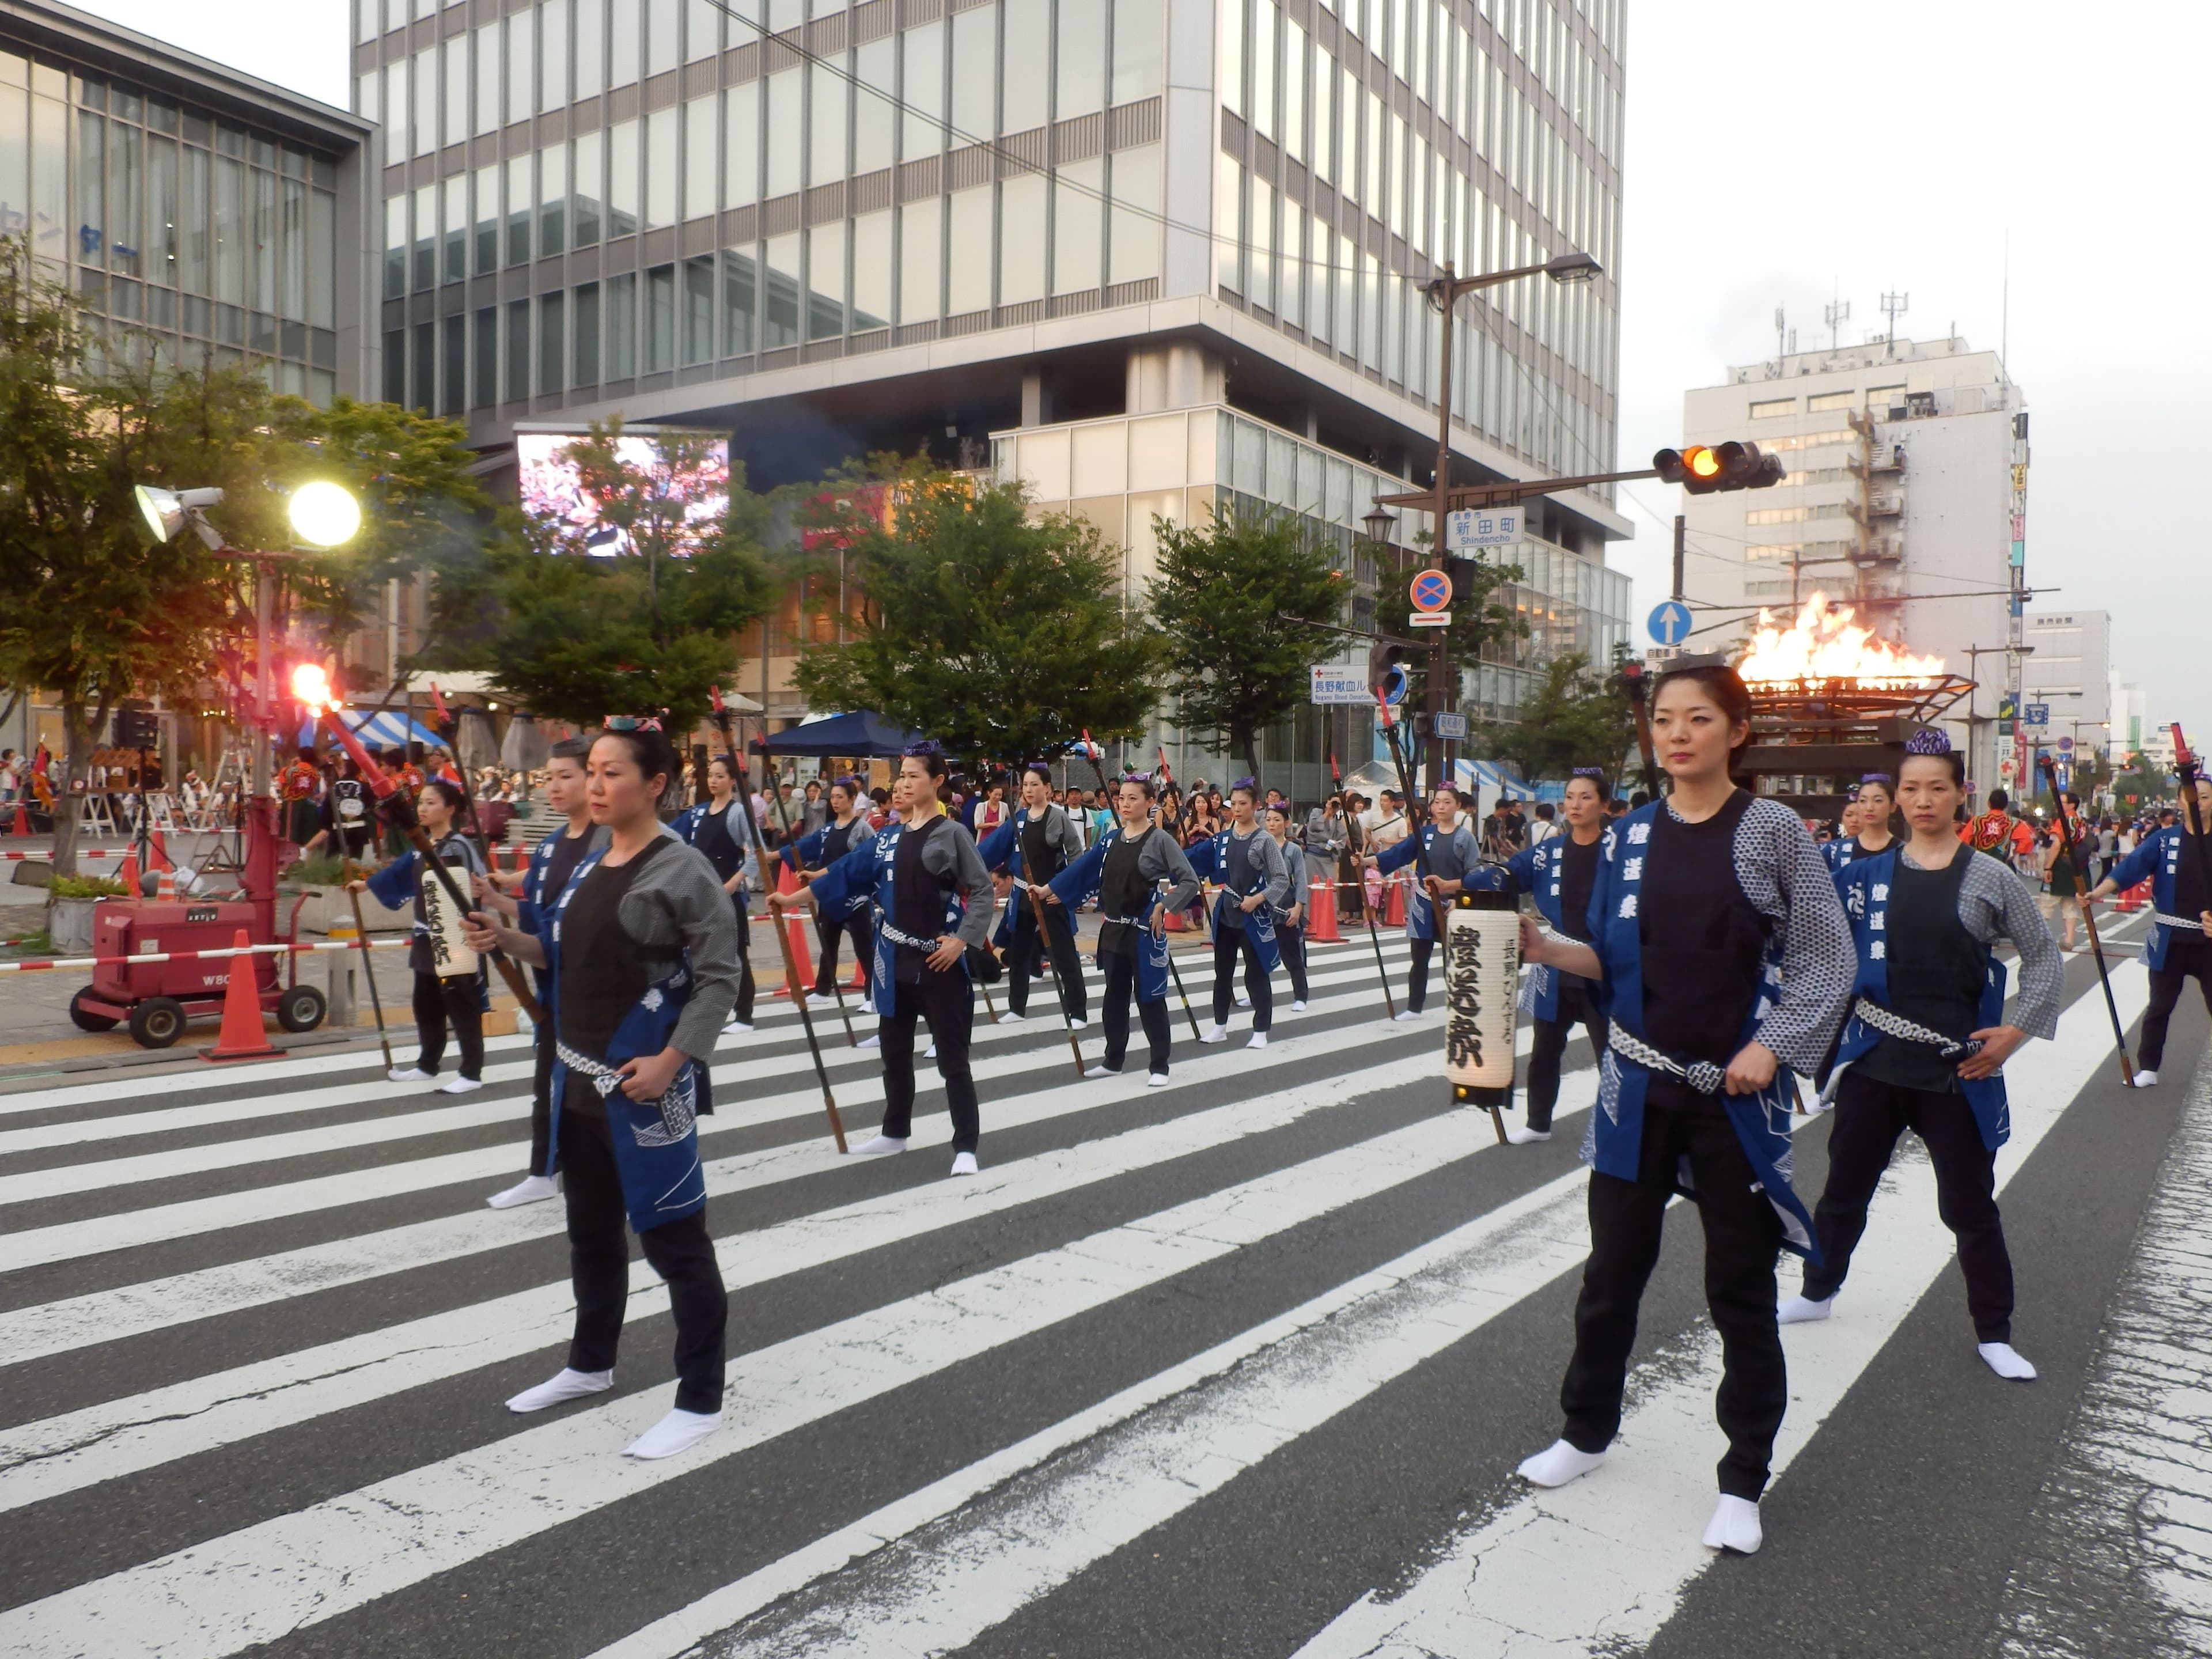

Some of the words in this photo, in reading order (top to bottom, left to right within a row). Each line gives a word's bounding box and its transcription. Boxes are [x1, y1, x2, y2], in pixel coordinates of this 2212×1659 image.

[1456, 517, 1515, 536] 新田町
[1461, 535, 1510, 545] Shindencho
